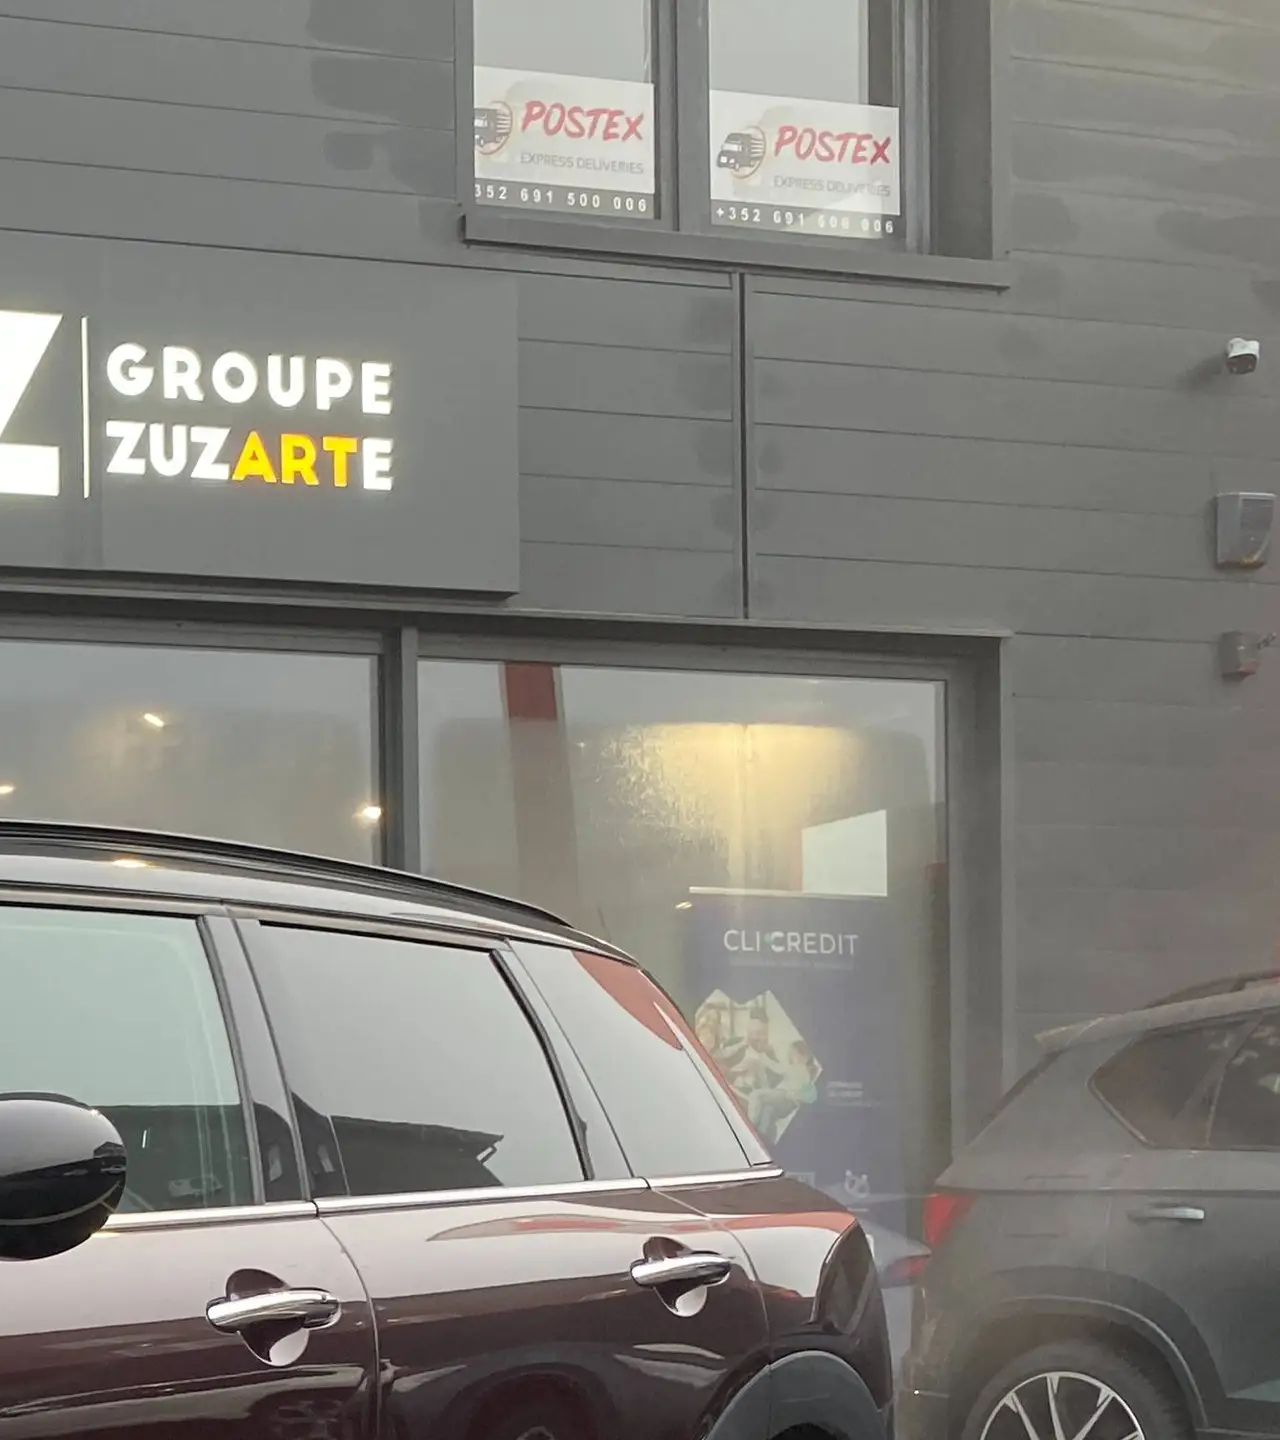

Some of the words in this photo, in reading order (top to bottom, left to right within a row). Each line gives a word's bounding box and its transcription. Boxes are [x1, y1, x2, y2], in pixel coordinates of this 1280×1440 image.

[521, 100, 643, 142] POSTEX
[774, 125, 892, 165] POSTEX
[521, 152, 573, 168] EXPRESS
[576, 156, 643, 174] DELIVERIES
[773, 175, 824, 192] EXPRESS
[521, 188, 553, 204] 691
[567, 192, 600, 208] 500
[613, 196, 646, 212] 006
[716, 207, 761, 222] +352
[106, 342, 392, 415] GROUPE
[105, 420, 392, 490] ZUZARTE
